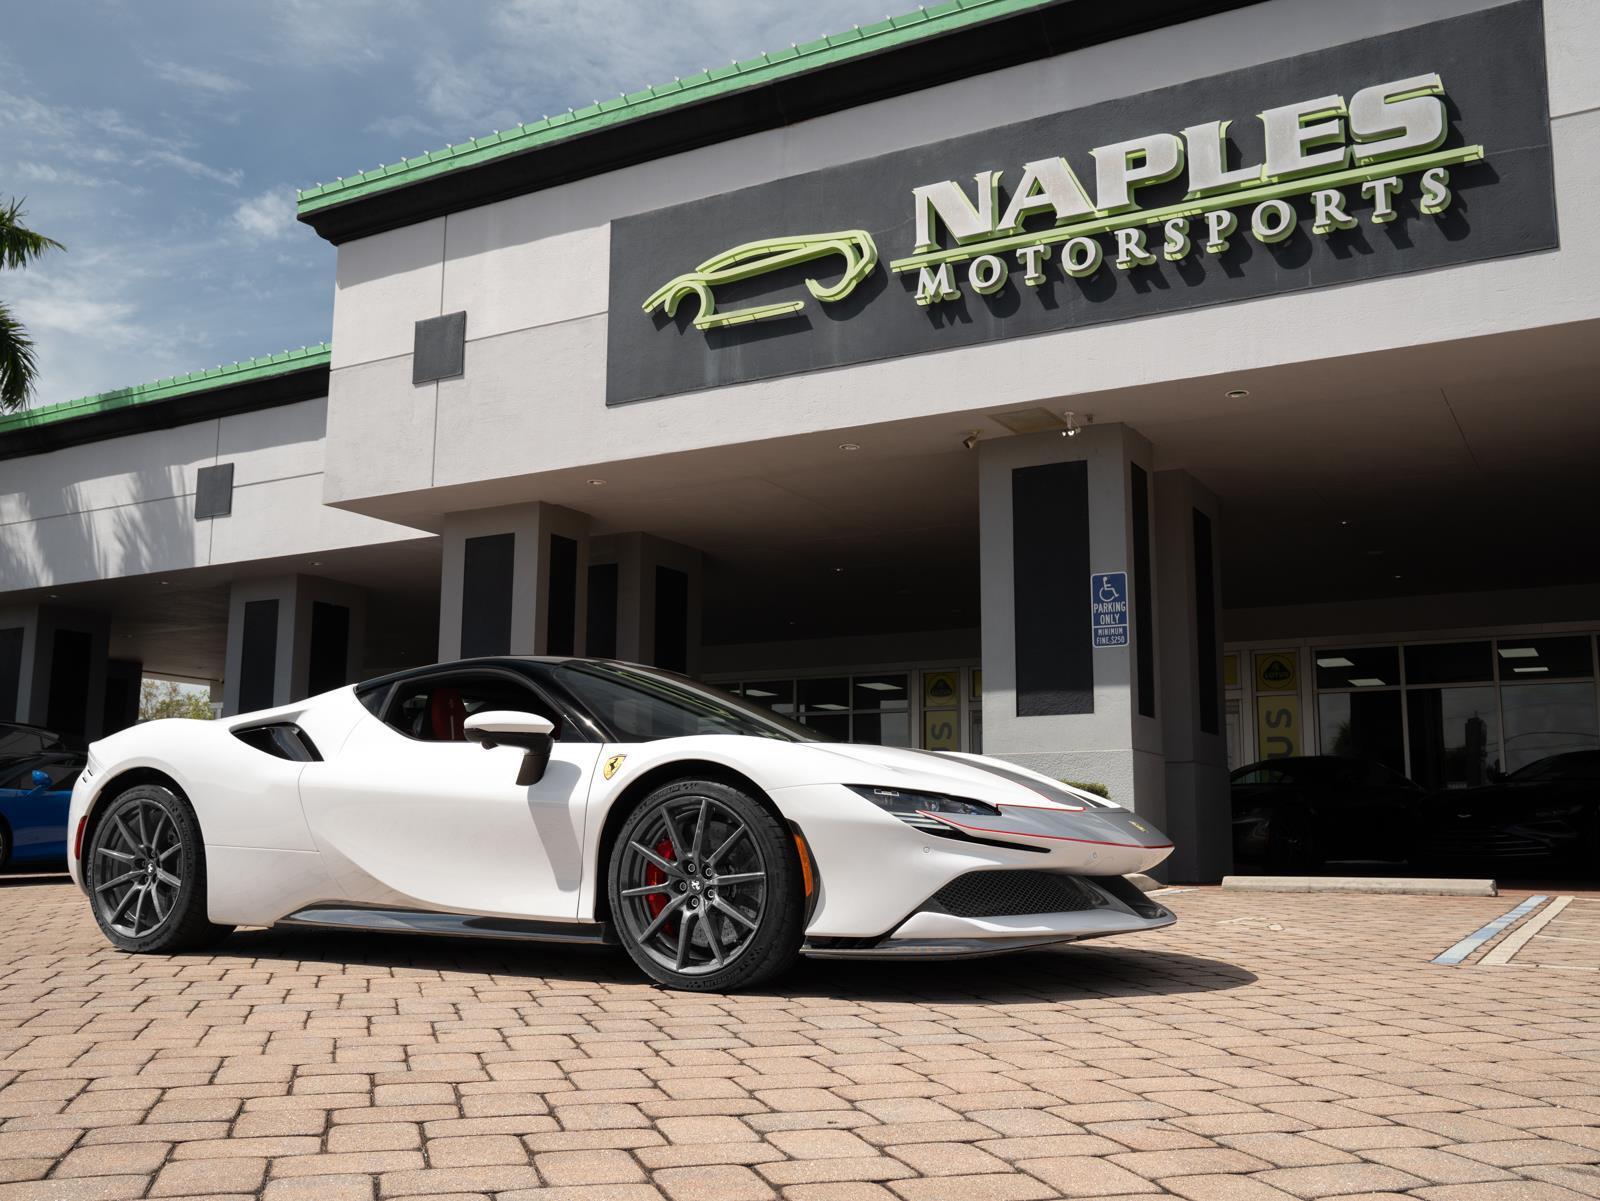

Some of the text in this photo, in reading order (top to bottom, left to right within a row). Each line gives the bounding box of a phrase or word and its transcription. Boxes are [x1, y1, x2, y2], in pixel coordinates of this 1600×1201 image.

[913, 73, 1447, 254] NAPLES
[914, 167, 1450, 306] MOTORSPORTS
[1093, 601, 1126, 613] PARKING
[1100, 613, 1120, 625] ONLY
[1098, 627, 1123, 636] MINIMUM
[1096, 636, 1109, 645] FINE
